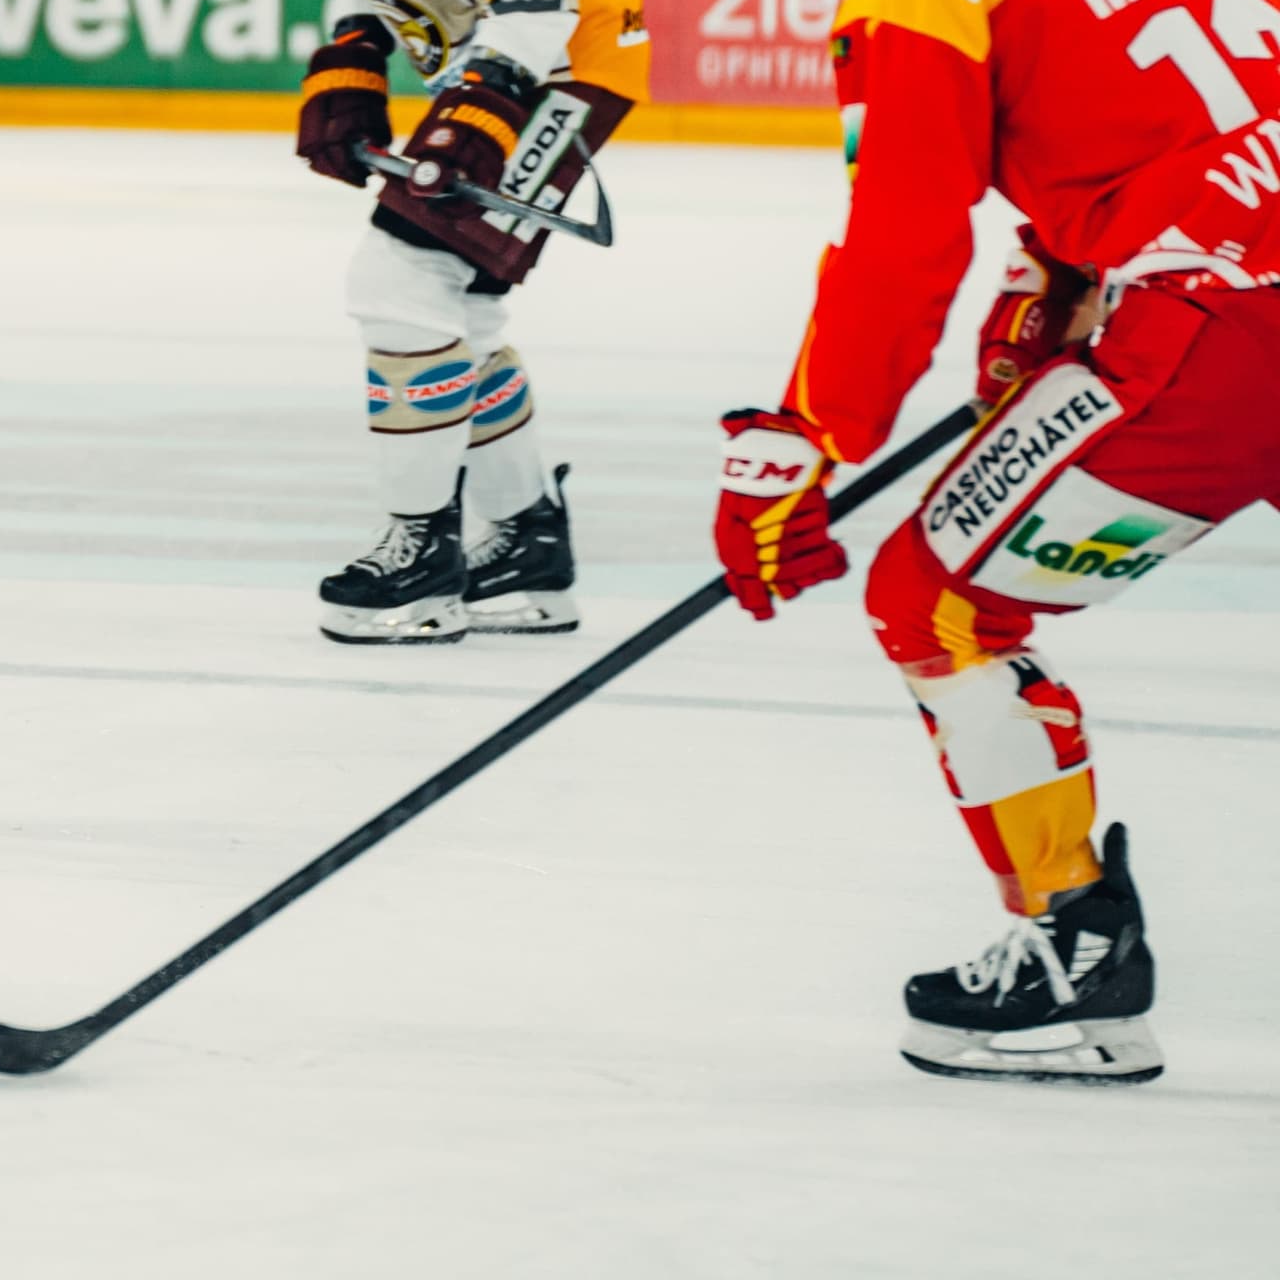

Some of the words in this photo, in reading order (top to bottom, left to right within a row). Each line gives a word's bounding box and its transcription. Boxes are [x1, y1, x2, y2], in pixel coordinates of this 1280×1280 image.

[504, 108, 574, 195] KODA
[928, 427, 1019, 532] CASINO
[953, 389, 1112, 538] NEUCHÂTEL
[1005, 513, 1167, 581] Landi
